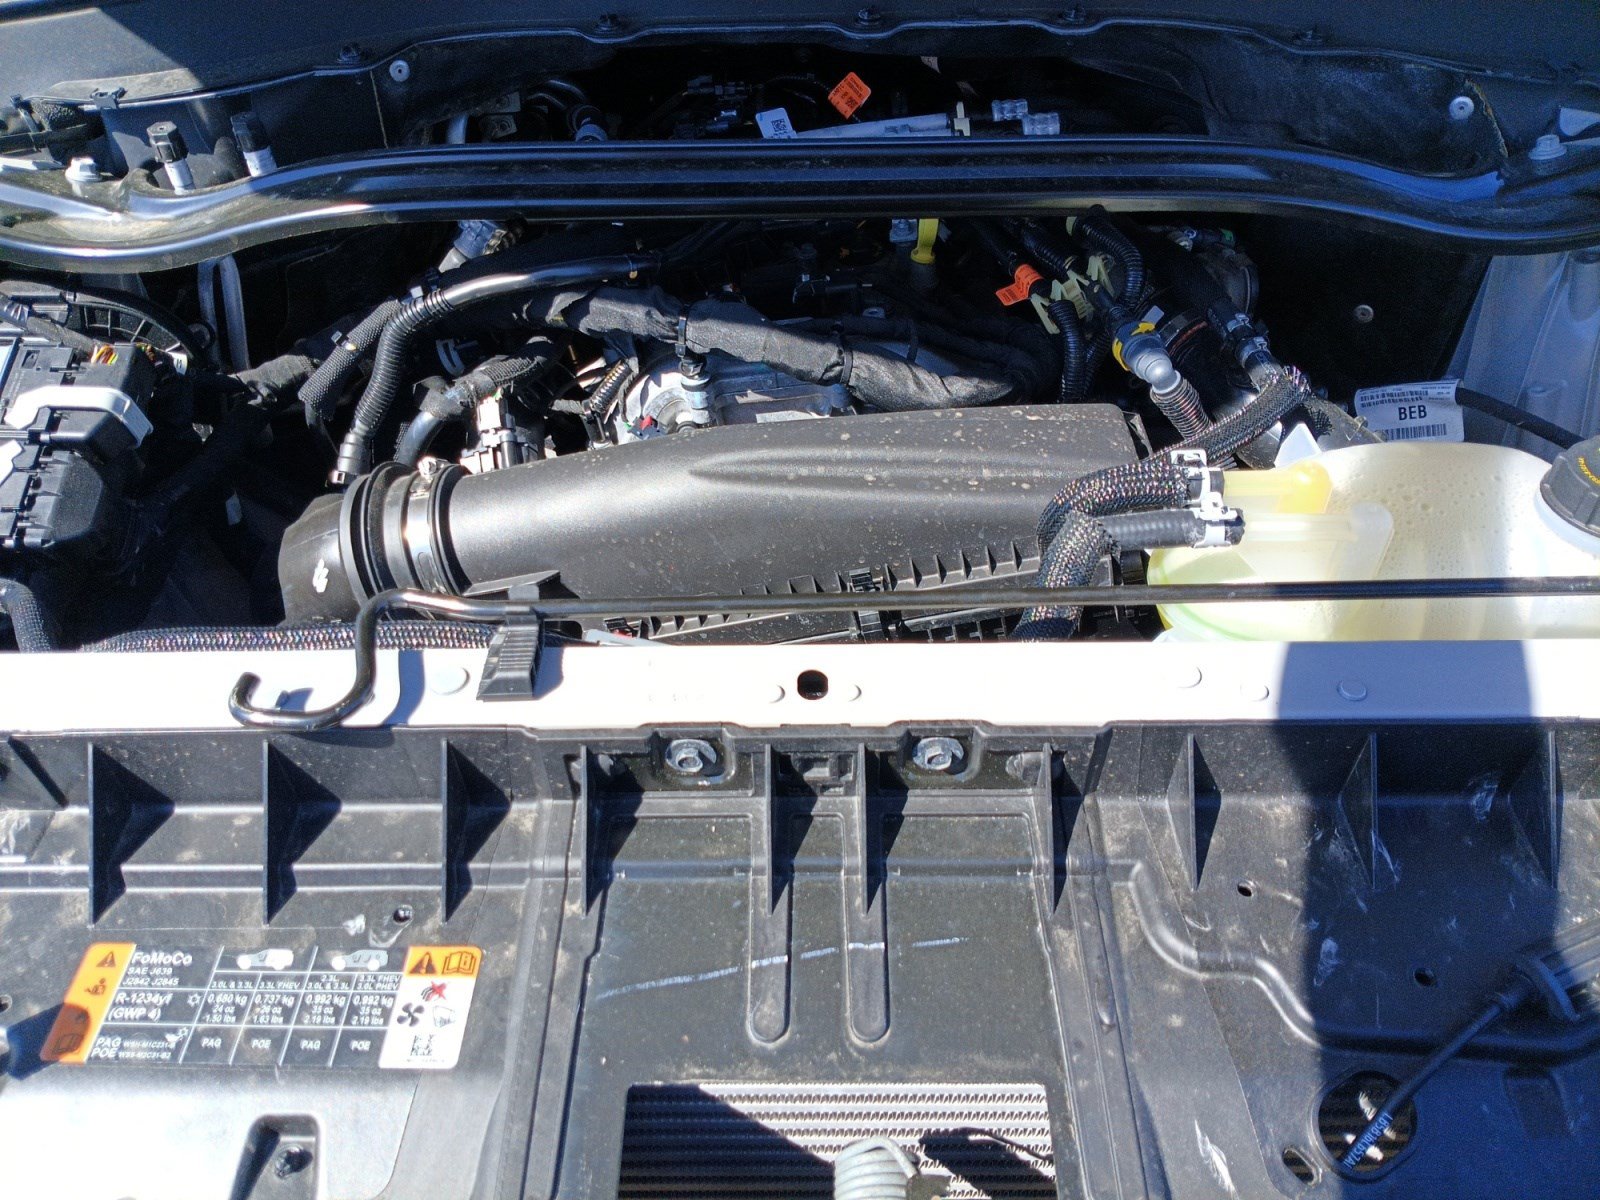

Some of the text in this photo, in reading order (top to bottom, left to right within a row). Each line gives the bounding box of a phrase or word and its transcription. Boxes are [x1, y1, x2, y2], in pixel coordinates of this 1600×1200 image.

[1398, 404, 1427, 420] BEB
[131, 951, 192, 966] FoMoCo
[150, 967, 172, 976] J639
[115, 992, 174, 1006] R-1234yf
[236, 994, 248, 1006] kg
[254, 994, 295, 1006] 0.737 kg
[333, 995, 346, 1006] kg
[382, 996, 394, 1008] kg
[108, 1008, 162, 1022] (GWP 4)
[360, 1006, 370, 1014] 35
[272, 1015, 284, 1023] lbs
[372, 1016, 384, 1024] lbs
[96, 1038, 122, 1048] PAG
[202, 1038, 222, 1047] PAG
[252, 1038, 272, 1048] POE
[300, 1040, 320, 1050] PAG
[351, 1040, 372, 1050] POE
[91, 1048, 117, 1058] POE
